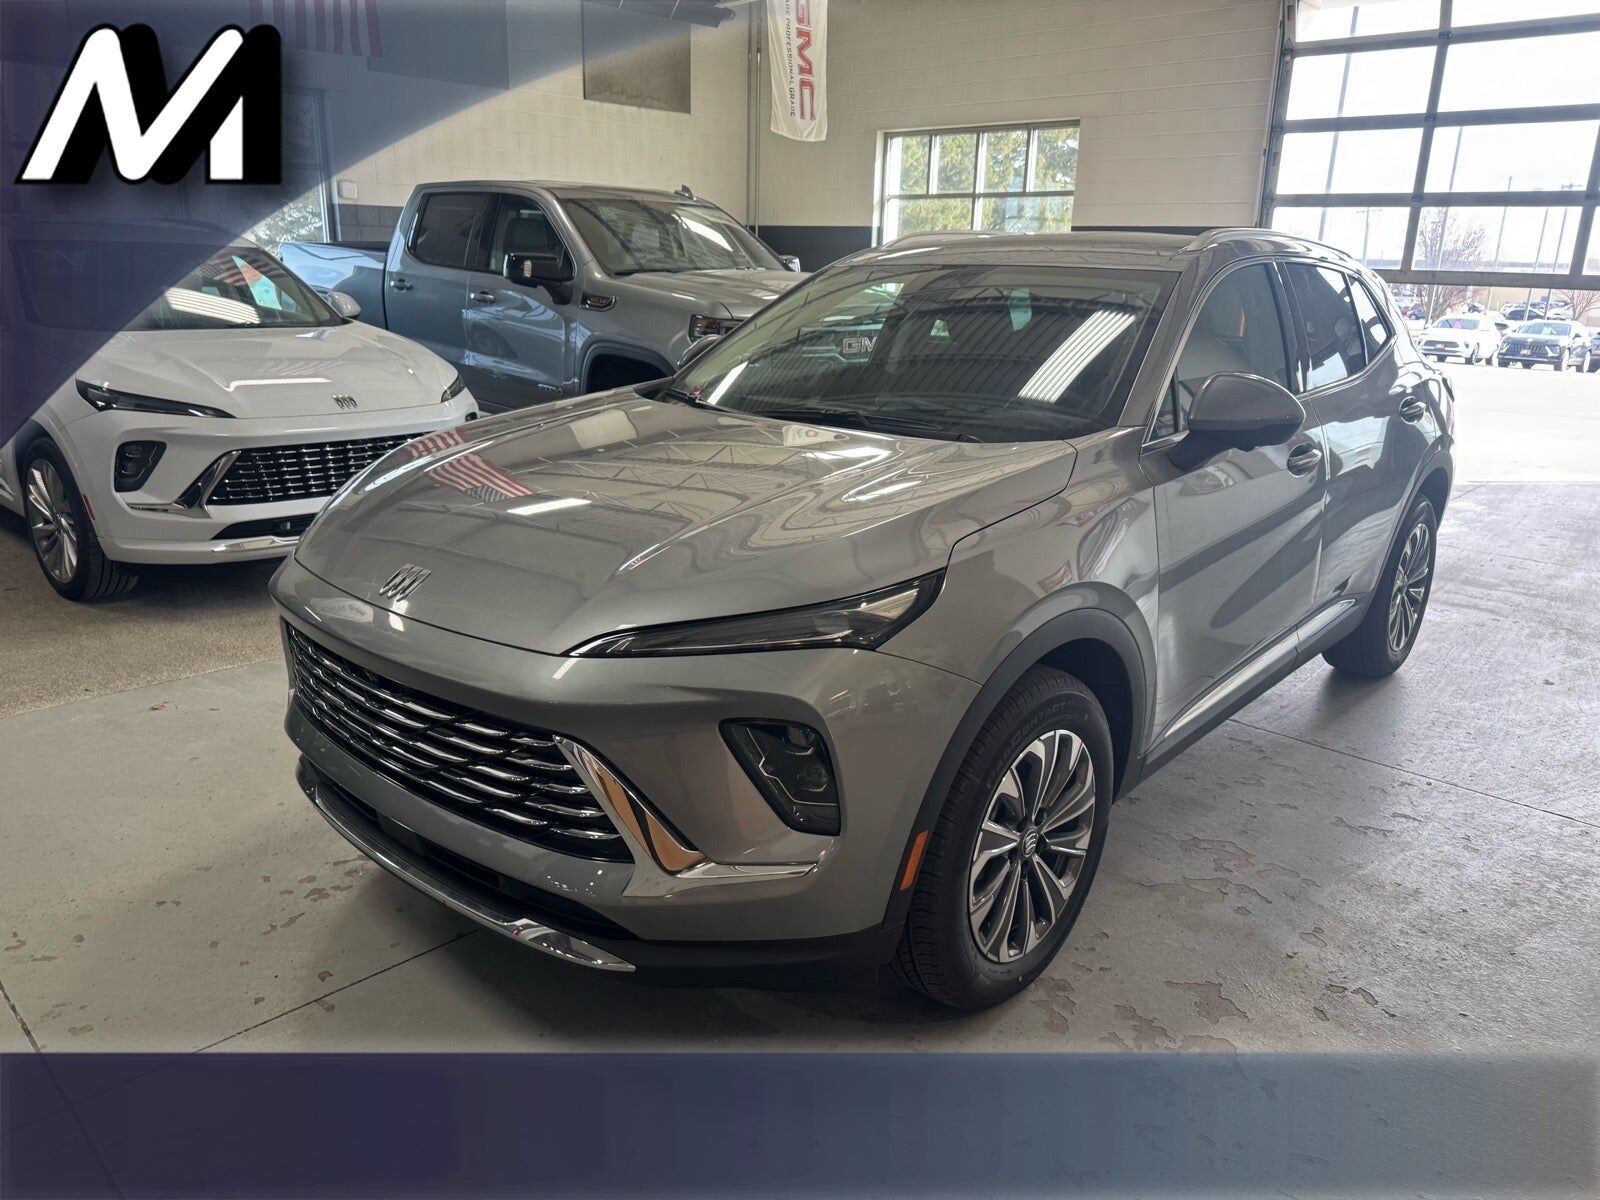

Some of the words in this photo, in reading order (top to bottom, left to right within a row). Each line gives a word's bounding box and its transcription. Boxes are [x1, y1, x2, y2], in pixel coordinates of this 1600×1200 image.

[785, 18, 794, 86] PROFESSIONAL
[796, 0, 816, 121] GMC
[788, 87, 796, 117] GRADE
